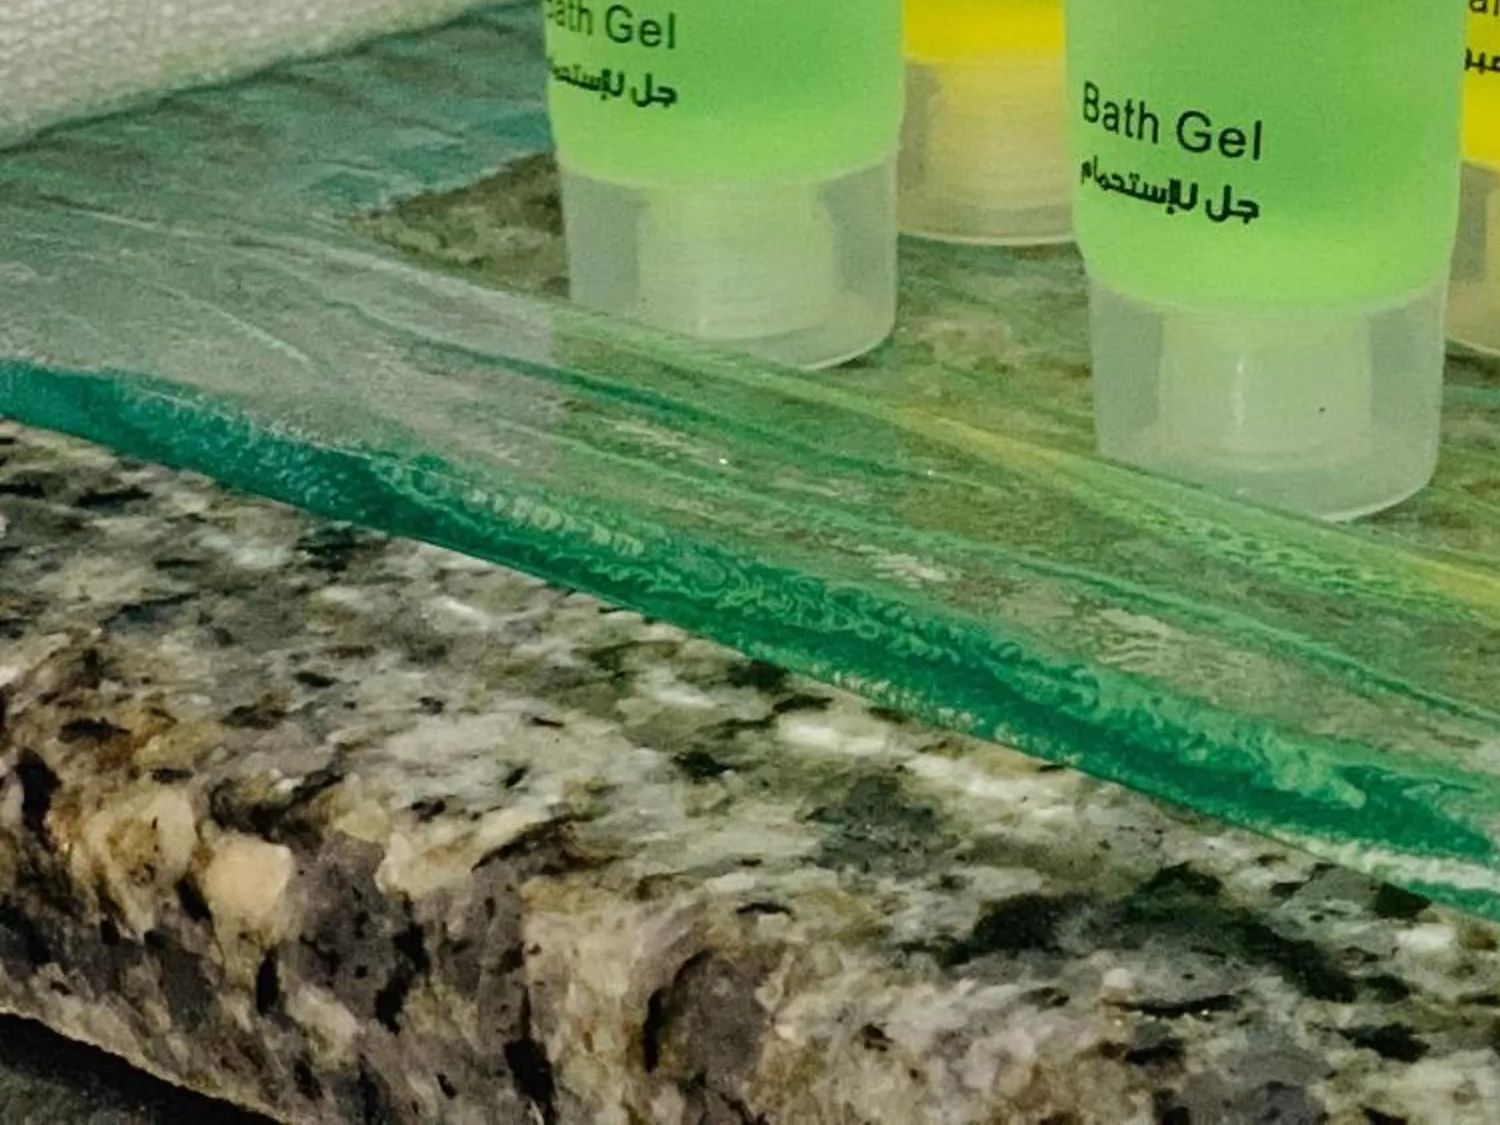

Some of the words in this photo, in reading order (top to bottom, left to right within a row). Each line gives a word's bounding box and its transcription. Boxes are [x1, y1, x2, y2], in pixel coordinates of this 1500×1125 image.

[605, 4, 676, 50] Gel
[1083, 80, 1159, 145] Bath
[1175, 110, 1263, 161] Gel
[1205, 184, 1260, 225] جل
